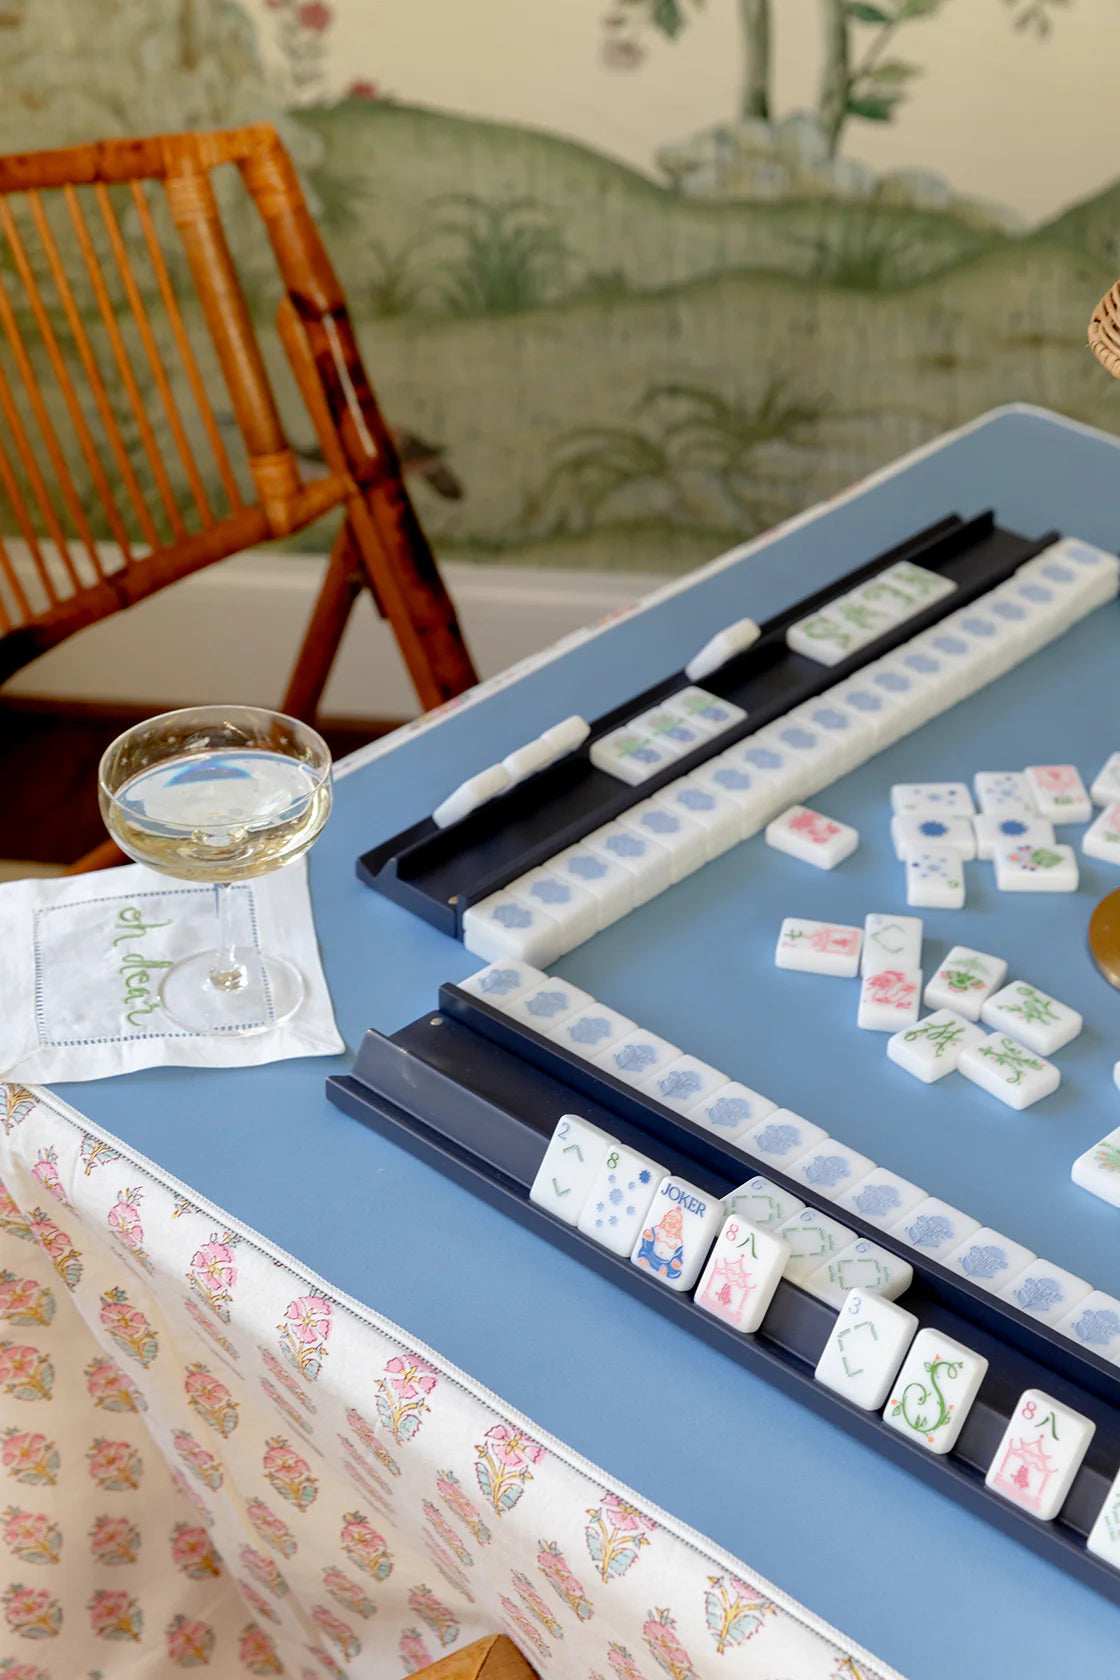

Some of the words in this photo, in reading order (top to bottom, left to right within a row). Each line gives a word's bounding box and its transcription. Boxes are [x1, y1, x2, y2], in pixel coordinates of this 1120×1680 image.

[113, 906, 173, 948] oh
[117, 952, 174, 1027] dear
[557, 1122, 570, 1141] 2
[606, 1151, 620, 1170] 8
[660, 1182, 707, 1219] JOKER
[725, 1223, 739, 1242] 8
[848, 1296, 862, 1315] 3
[898, 1357, 964, 1436] S
[1021, 1401, 1037, 1421] 8
